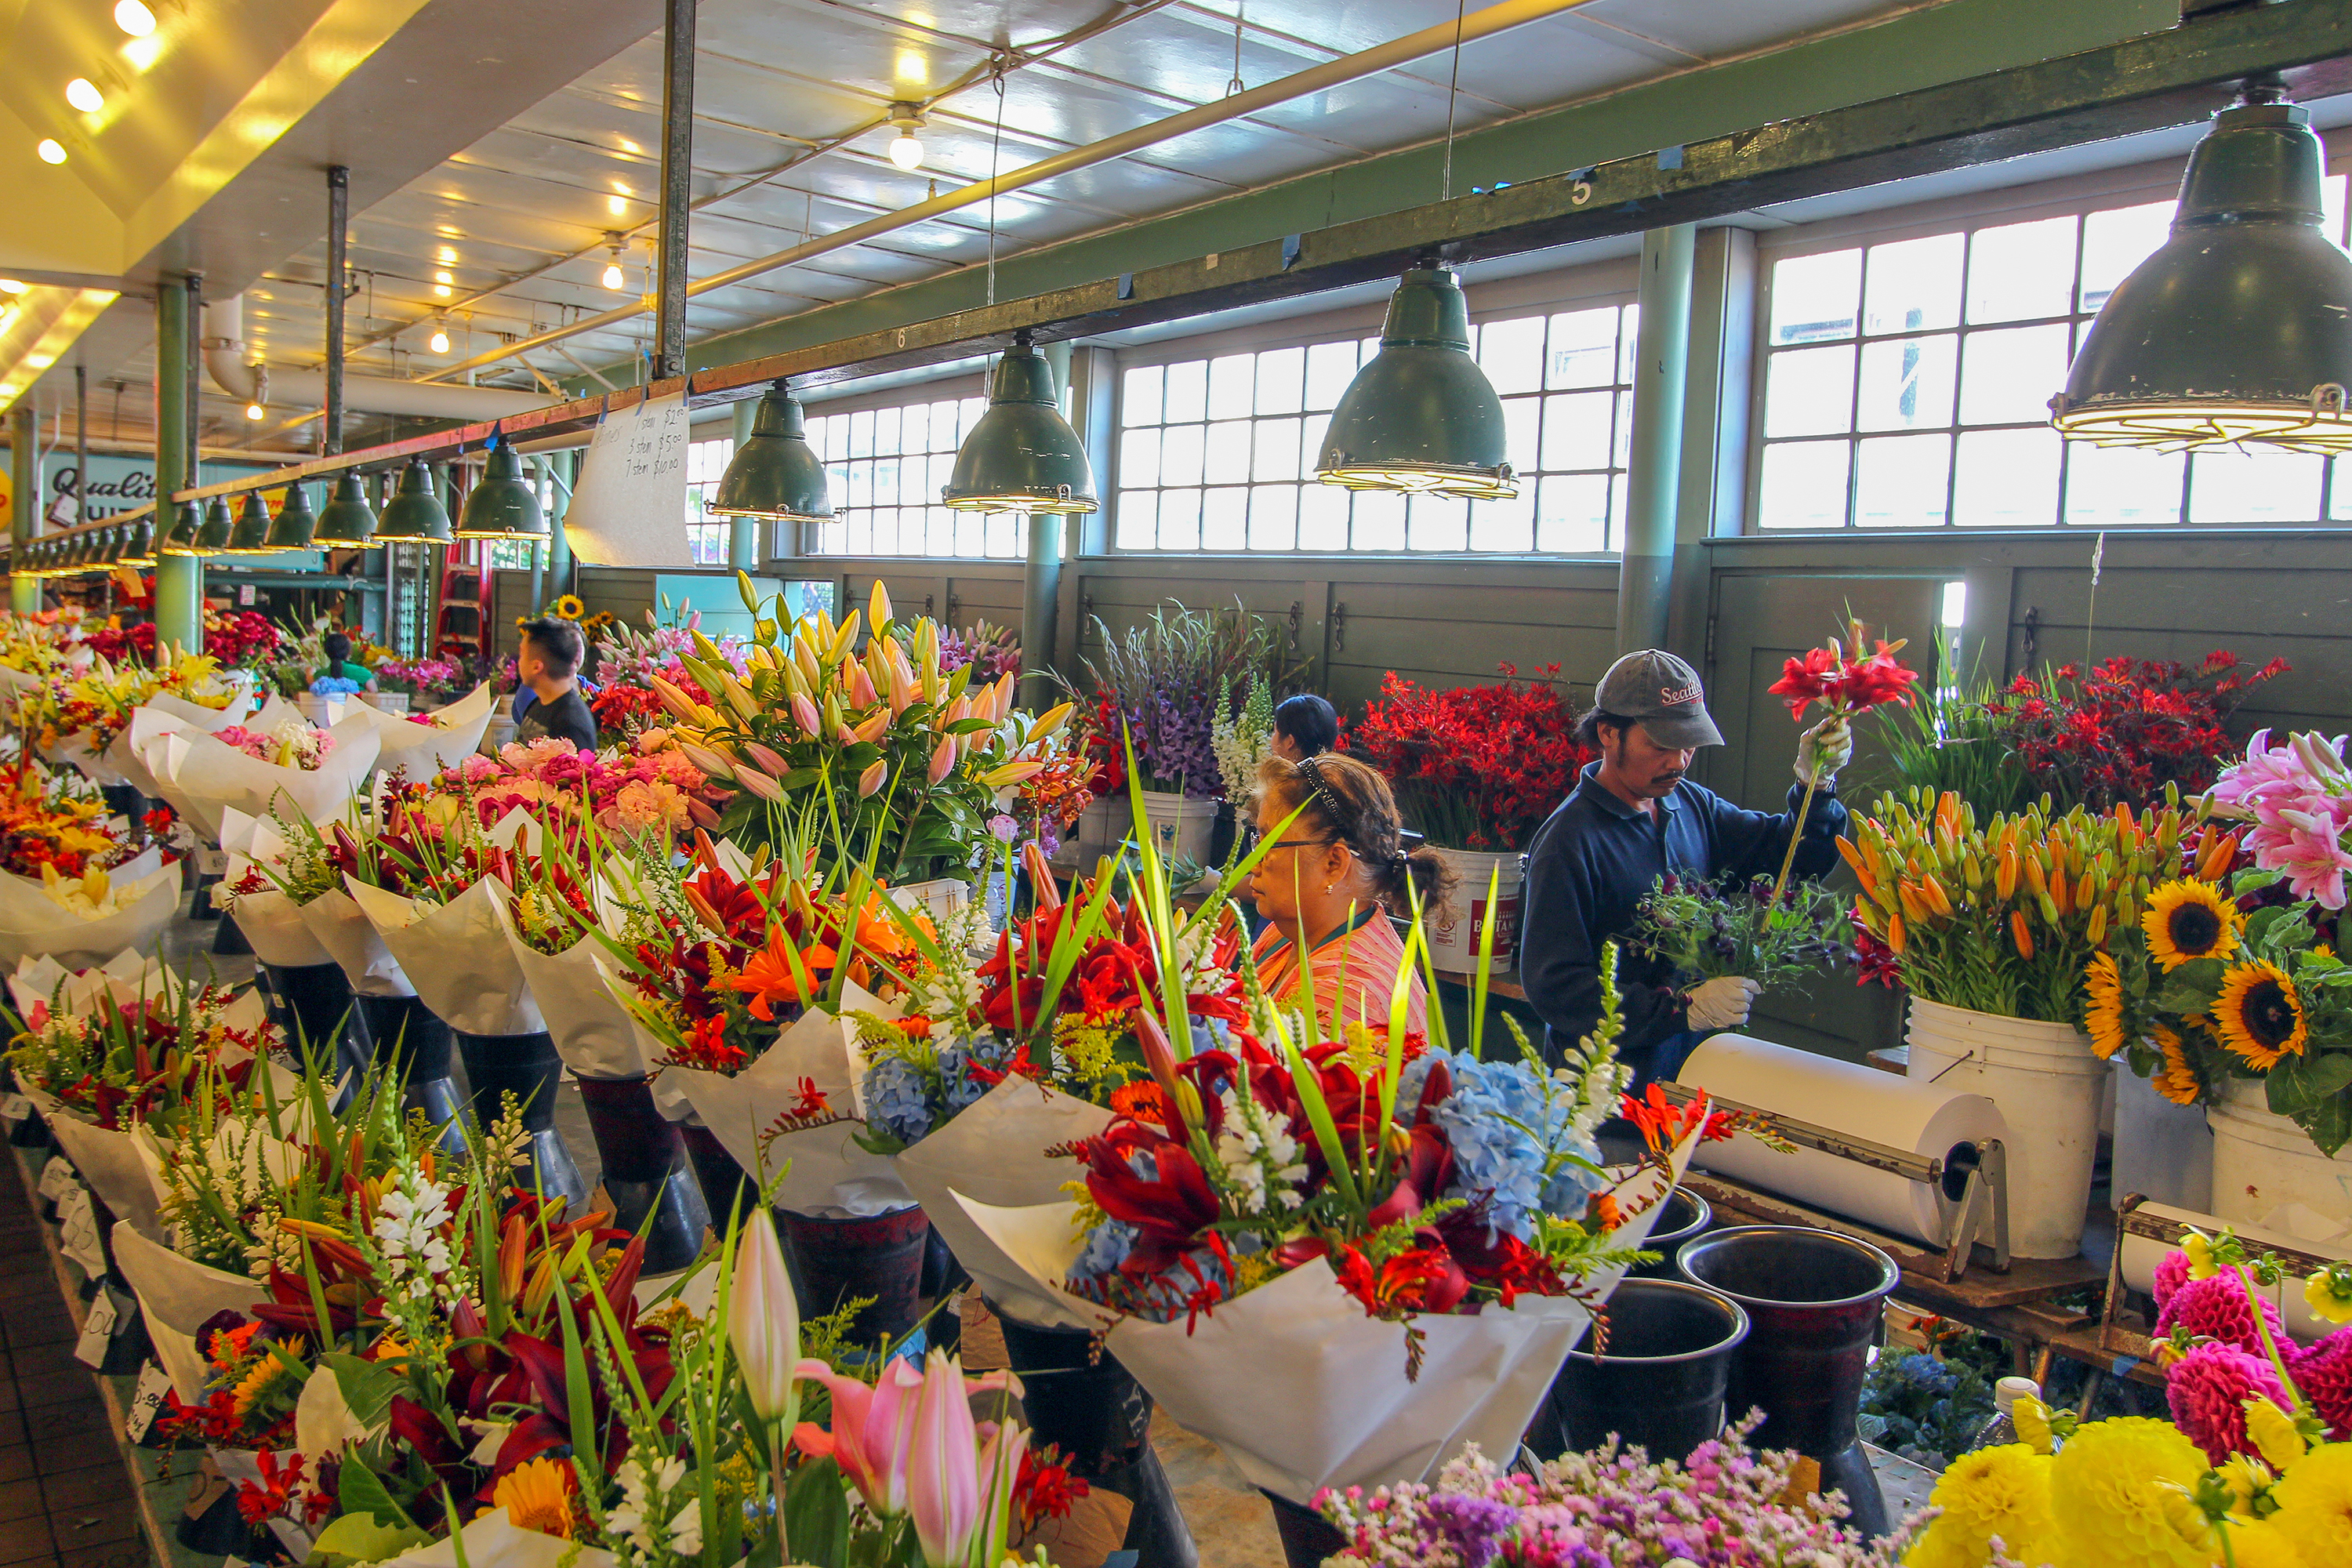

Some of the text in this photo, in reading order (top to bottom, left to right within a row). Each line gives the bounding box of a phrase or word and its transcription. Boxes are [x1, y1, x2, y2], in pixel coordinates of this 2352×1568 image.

[1571, 177, 1592, 205] 5
[898, 328, 906, 348] 6
[629, 433, 682, 456] 3 stem $5.00
[626, 456, 679, 479] 7 stem $10.00
[1661, 680, 1702, 704] Seattle
